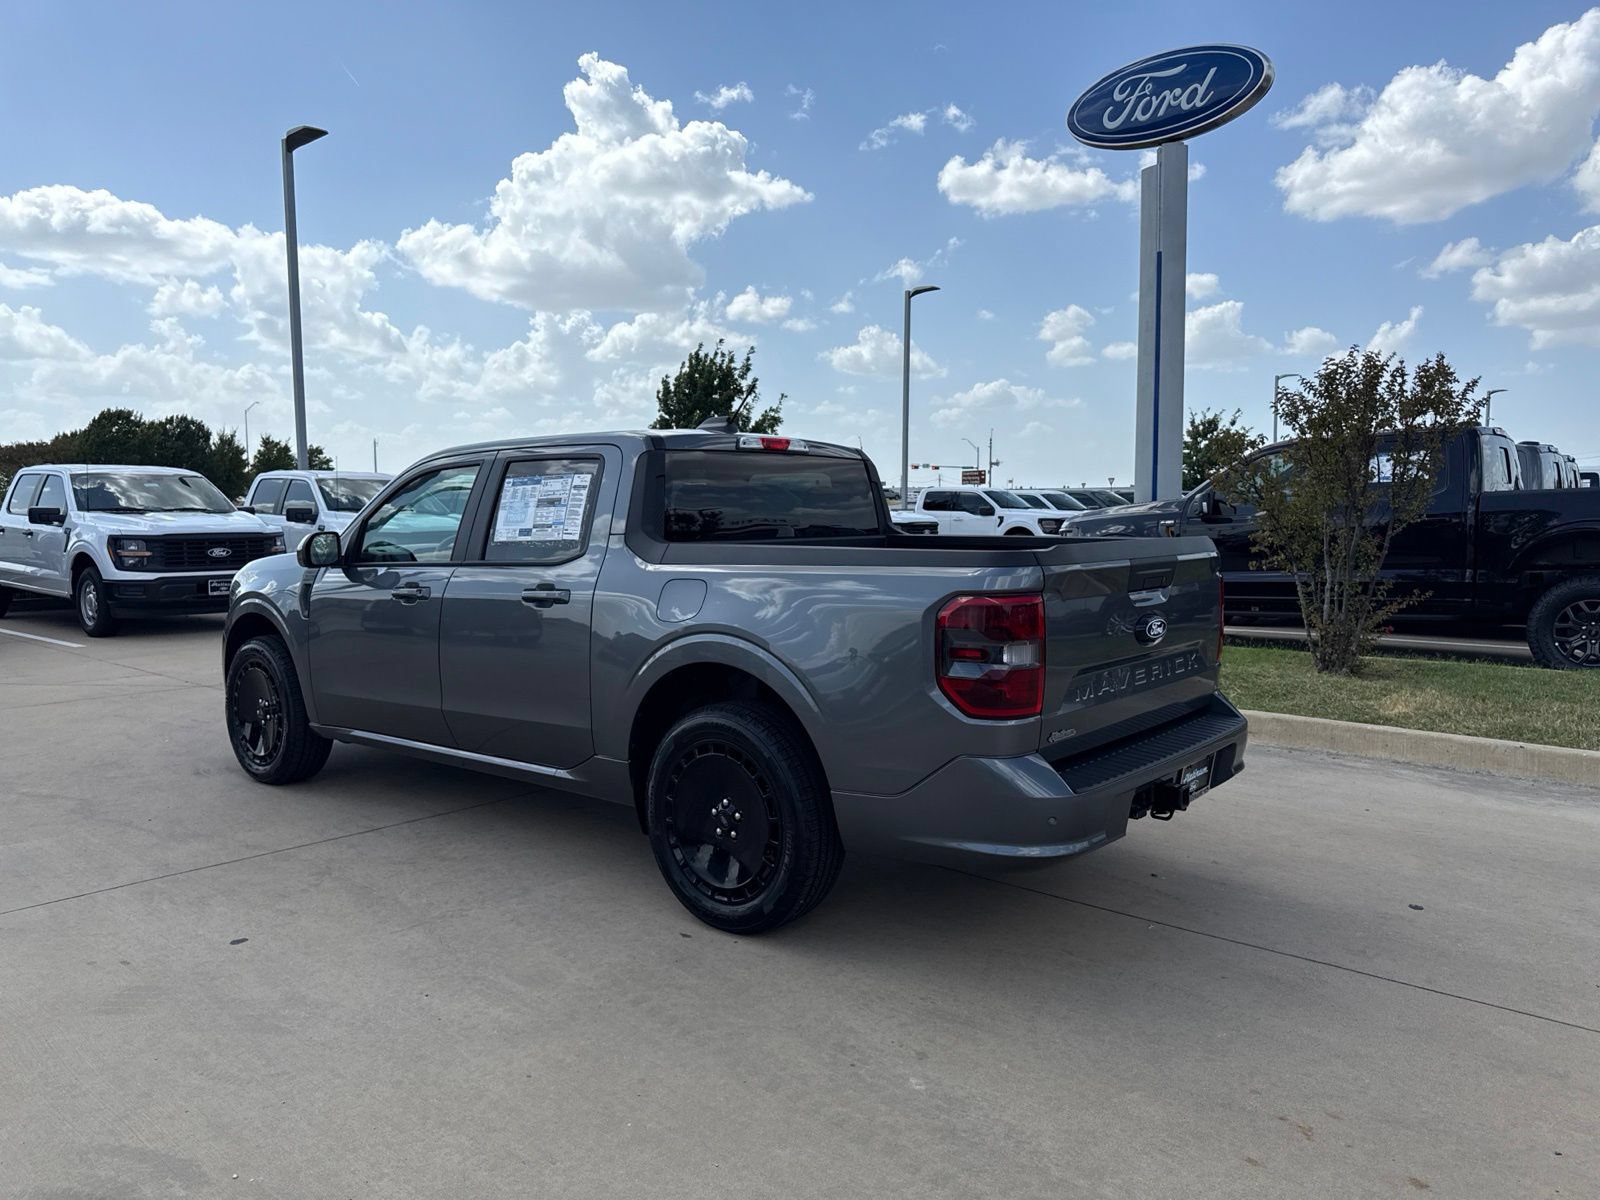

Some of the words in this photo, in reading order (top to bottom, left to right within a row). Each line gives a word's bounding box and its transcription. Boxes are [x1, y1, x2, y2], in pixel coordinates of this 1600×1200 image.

[1102, 63, 1218, 130] Ford
[211, 548, 228, 557] Ford
[1150, 620, 1165, 636] Ford
[1075, 653, 1199, 703] MAVERICK
